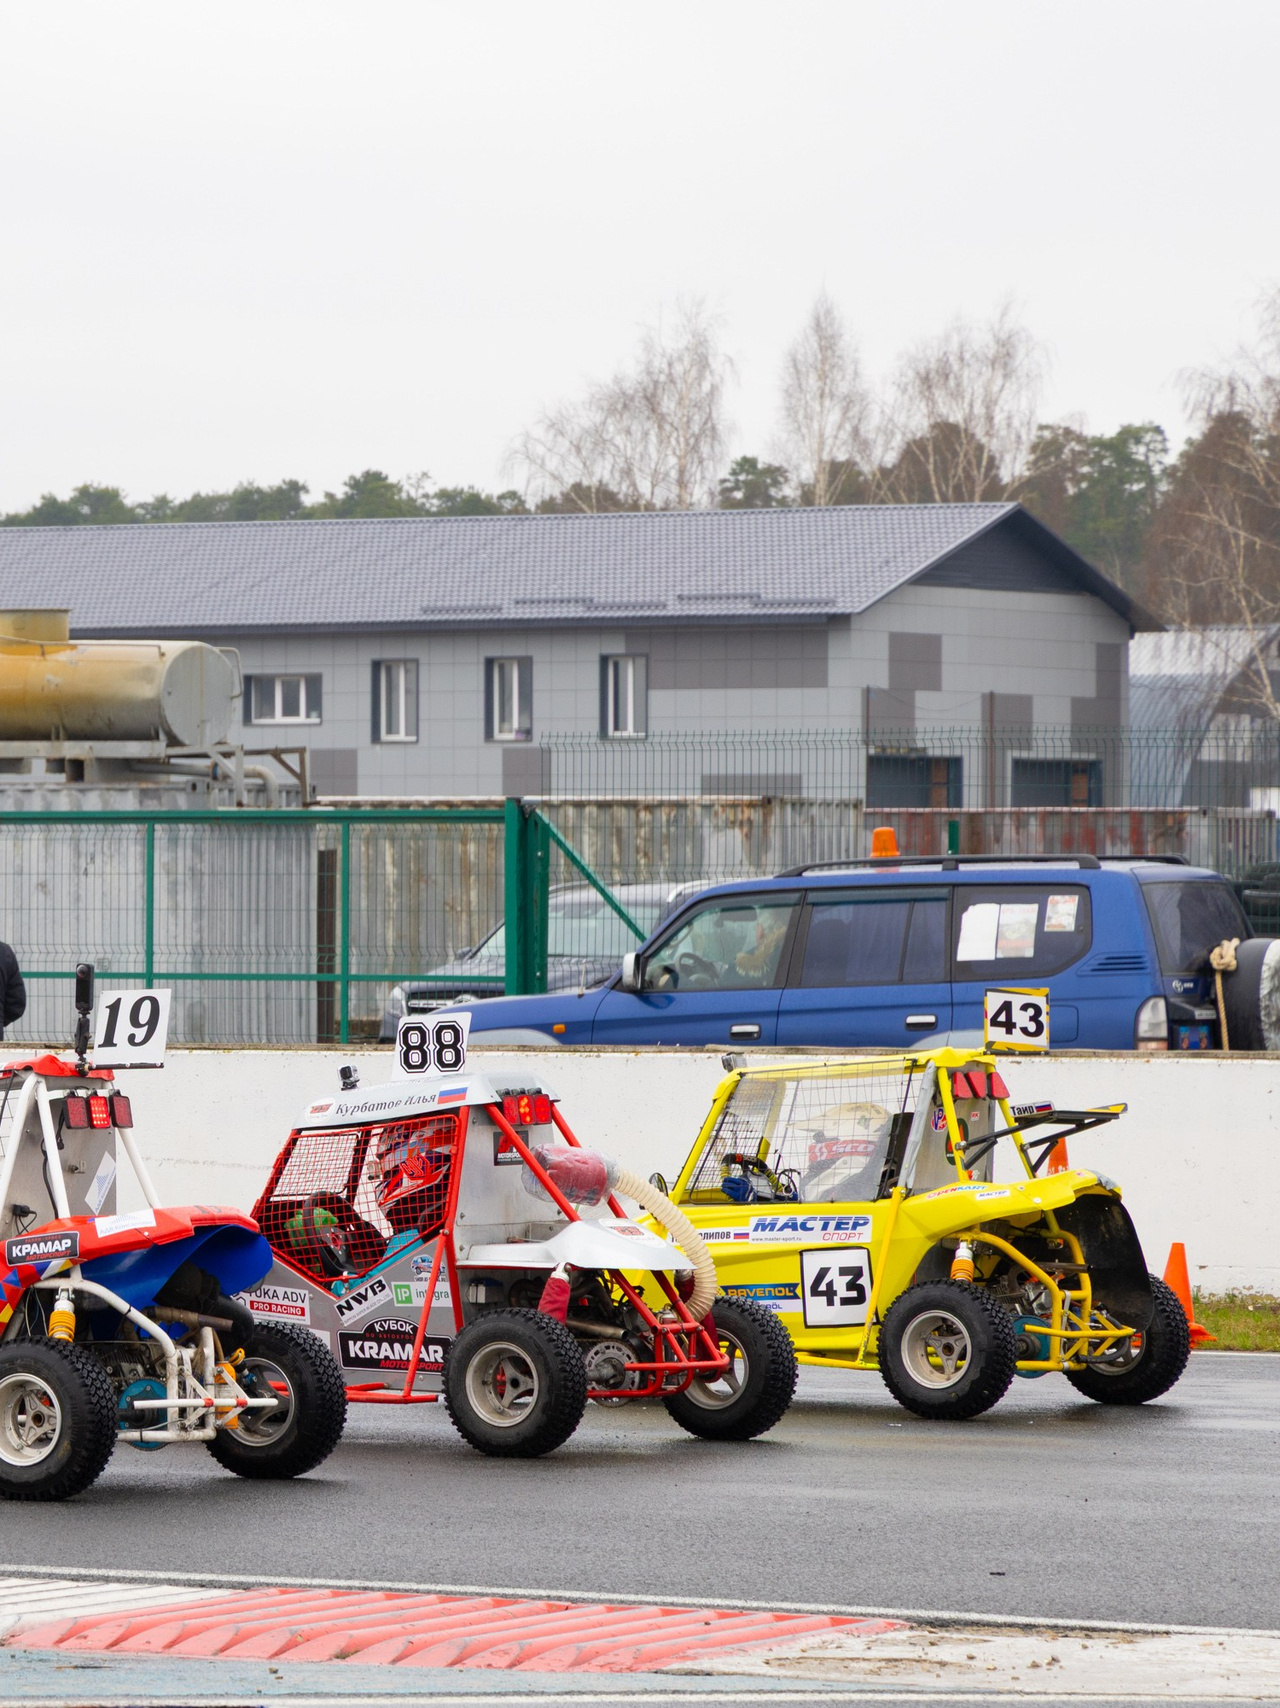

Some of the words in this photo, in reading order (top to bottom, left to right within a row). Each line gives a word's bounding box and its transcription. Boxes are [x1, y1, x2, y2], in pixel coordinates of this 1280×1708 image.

[98, 996, 160, 1048] 19
[990, 1000, 1045, 1038] 43
[399, 1021, 465, 1073] 88
[1011, 1105, 1035, 1116] Таир
[752, 1216, 871, 1232] МАСТЕР
[822, 1232, 864, 1241] СПОРТ
[12, 1239, 72, 1257] КРАМАР
[25, 1250, 71, 1261] МОТОРСПОРТ
[416, 1287, 450, 1301] intgra
[727, 1286, 794, 1297] RAVENOL
[809, 1266, 867, 1307] 43
[282, 1290, 307, 1304] ADV
[336, 1279, 387, 1316] NWB
[253, 1302, 270, 1311] PRO
[271, 1304, 302, 1315] RACING
[374, 1320, 414, 1334] КУБОК
[348, 1340, 444, 1363] KRAMAR
